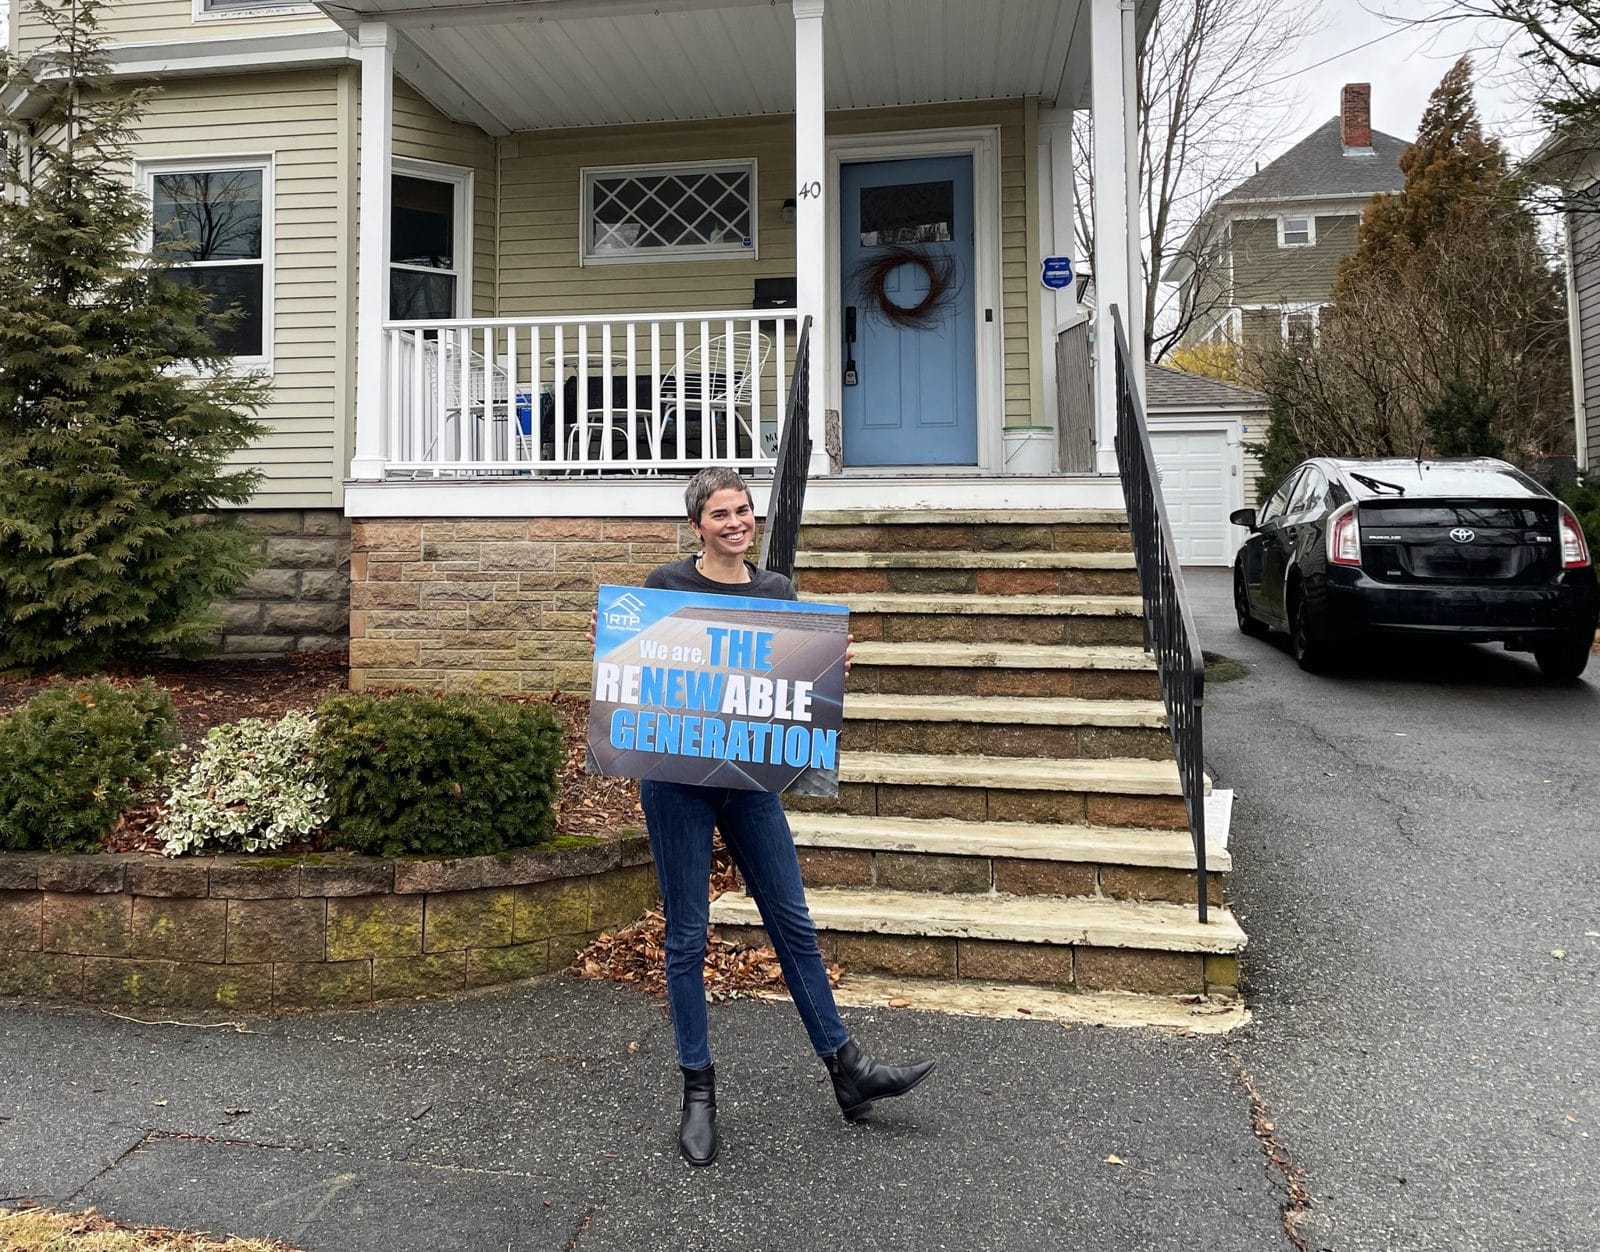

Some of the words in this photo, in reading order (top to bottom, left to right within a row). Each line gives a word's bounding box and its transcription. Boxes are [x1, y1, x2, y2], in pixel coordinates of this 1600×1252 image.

[798, 181, 821, 200] 40
[639, 639, 668, 660] We
[671, 645, 708, 664] are,
[706, 626, 774, 672] THE
[595, 662, 814, 722] RENEWABLE
[609, 707, 838, 771] GENERATION
